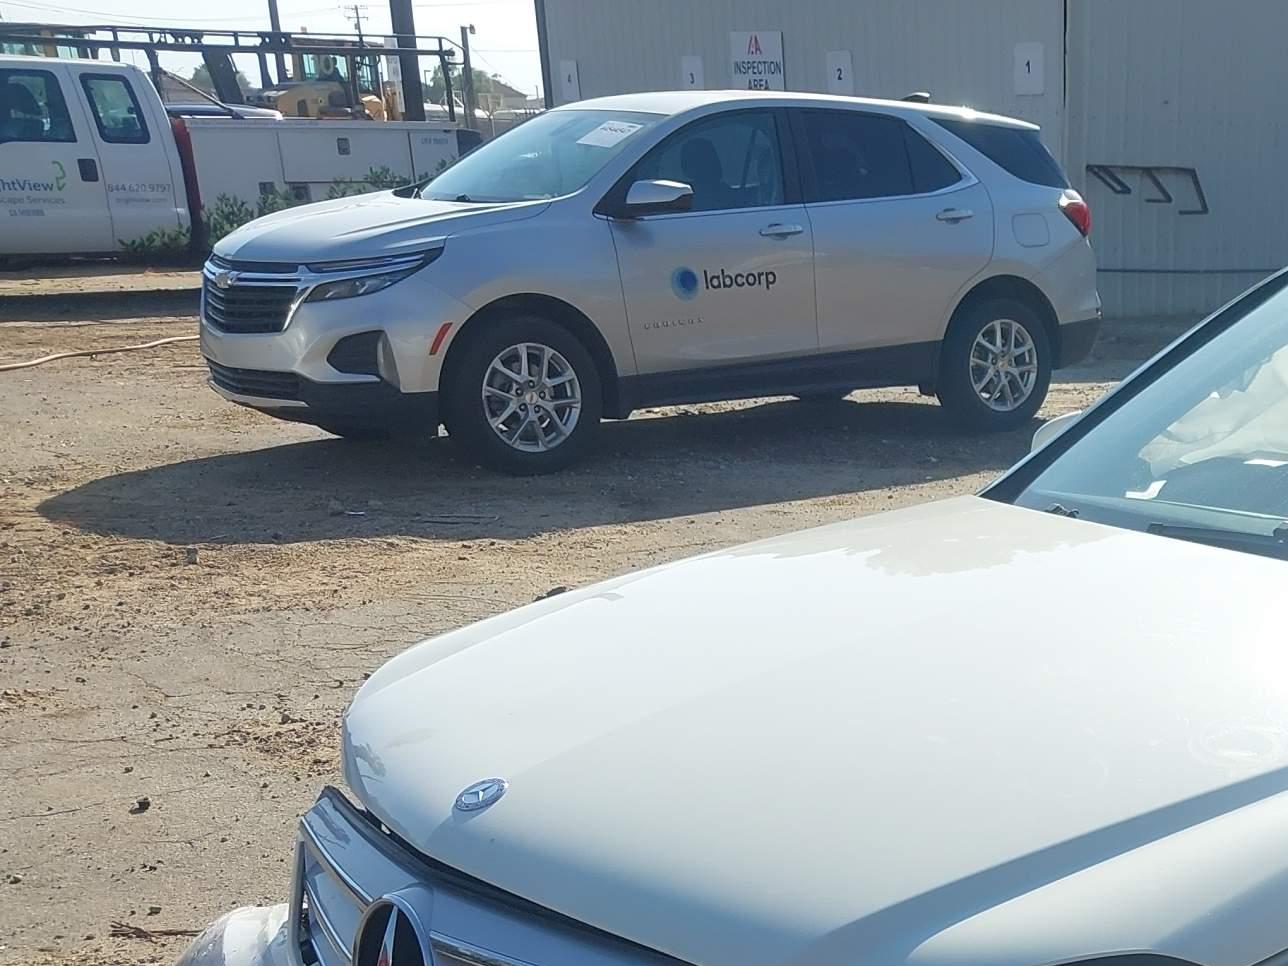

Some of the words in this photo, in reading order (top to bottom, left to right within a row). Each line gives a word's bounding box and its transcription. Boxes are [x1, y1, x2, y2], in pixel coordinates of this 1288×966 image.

[733, 60, 782, 75] INSPECTION
[1025, 59, 1031, 74] 1
[836, 67, 843, 81] 2
[748, 78, 770, 90] AREA
[0, 178, 54, 192] htView
[703, 268, 777, 290] labcorp
